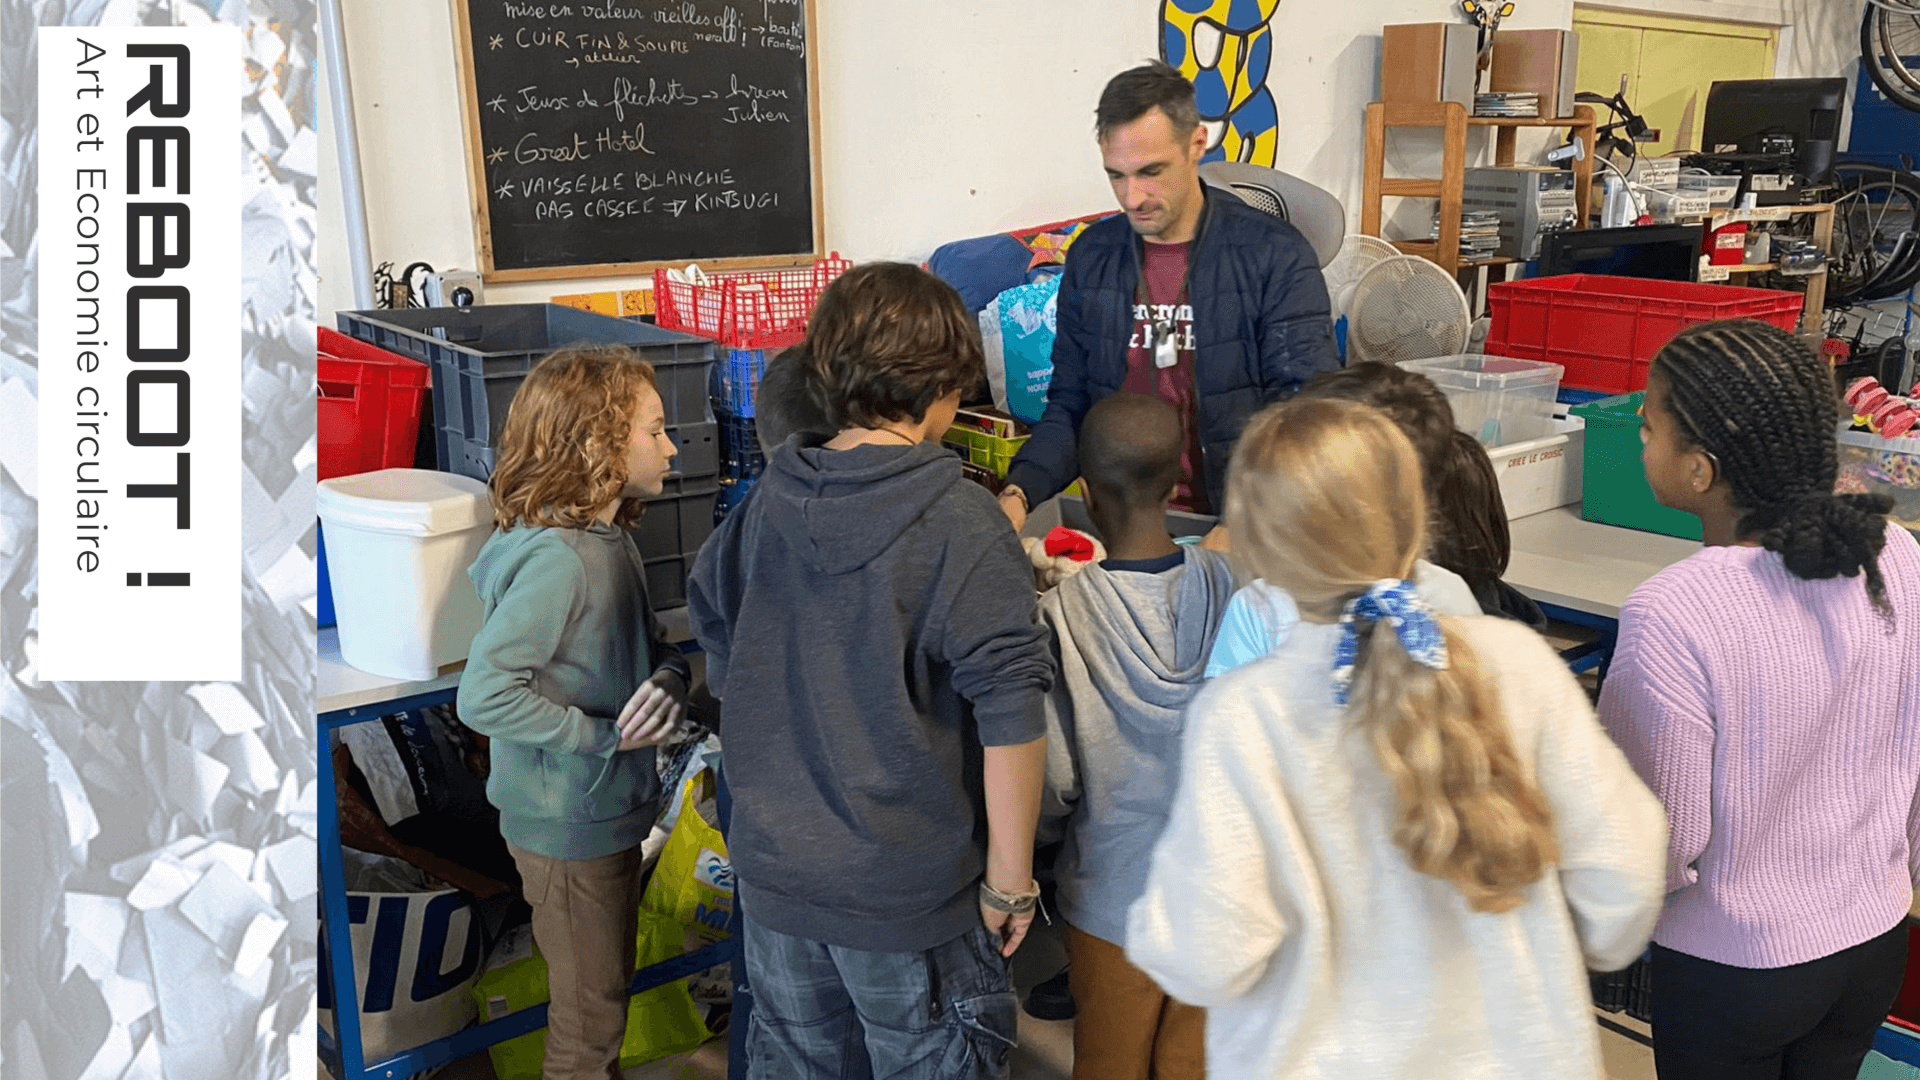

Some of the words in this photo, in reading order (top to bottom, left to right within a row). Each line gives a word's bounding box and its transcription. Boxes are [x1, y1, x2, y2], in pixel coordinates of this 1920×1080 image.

[503, 2, 547, 19] mise
[550, 4, 574, 18] en
[581, 0, 644, 19] valeur
[653, 1, 711, 26] vieilles
[617, 31, 630, 50] &
[584, 51, 641, 64] atelier
[516, 86, 570, 113] Jeux
[577, 88, 599, 108] de
[721, 99, 790, 123] Julien
[596, 122, 655, 155] Hotel
[522, 173, 624, 198] VAISSELLE
[635, 168, 735, 191] BLANCHE
[535, 200, 573, 220] PAS
[584, 197, 655, 218] CASSEE
[695, 190, 778, 212] KINTSUGI
